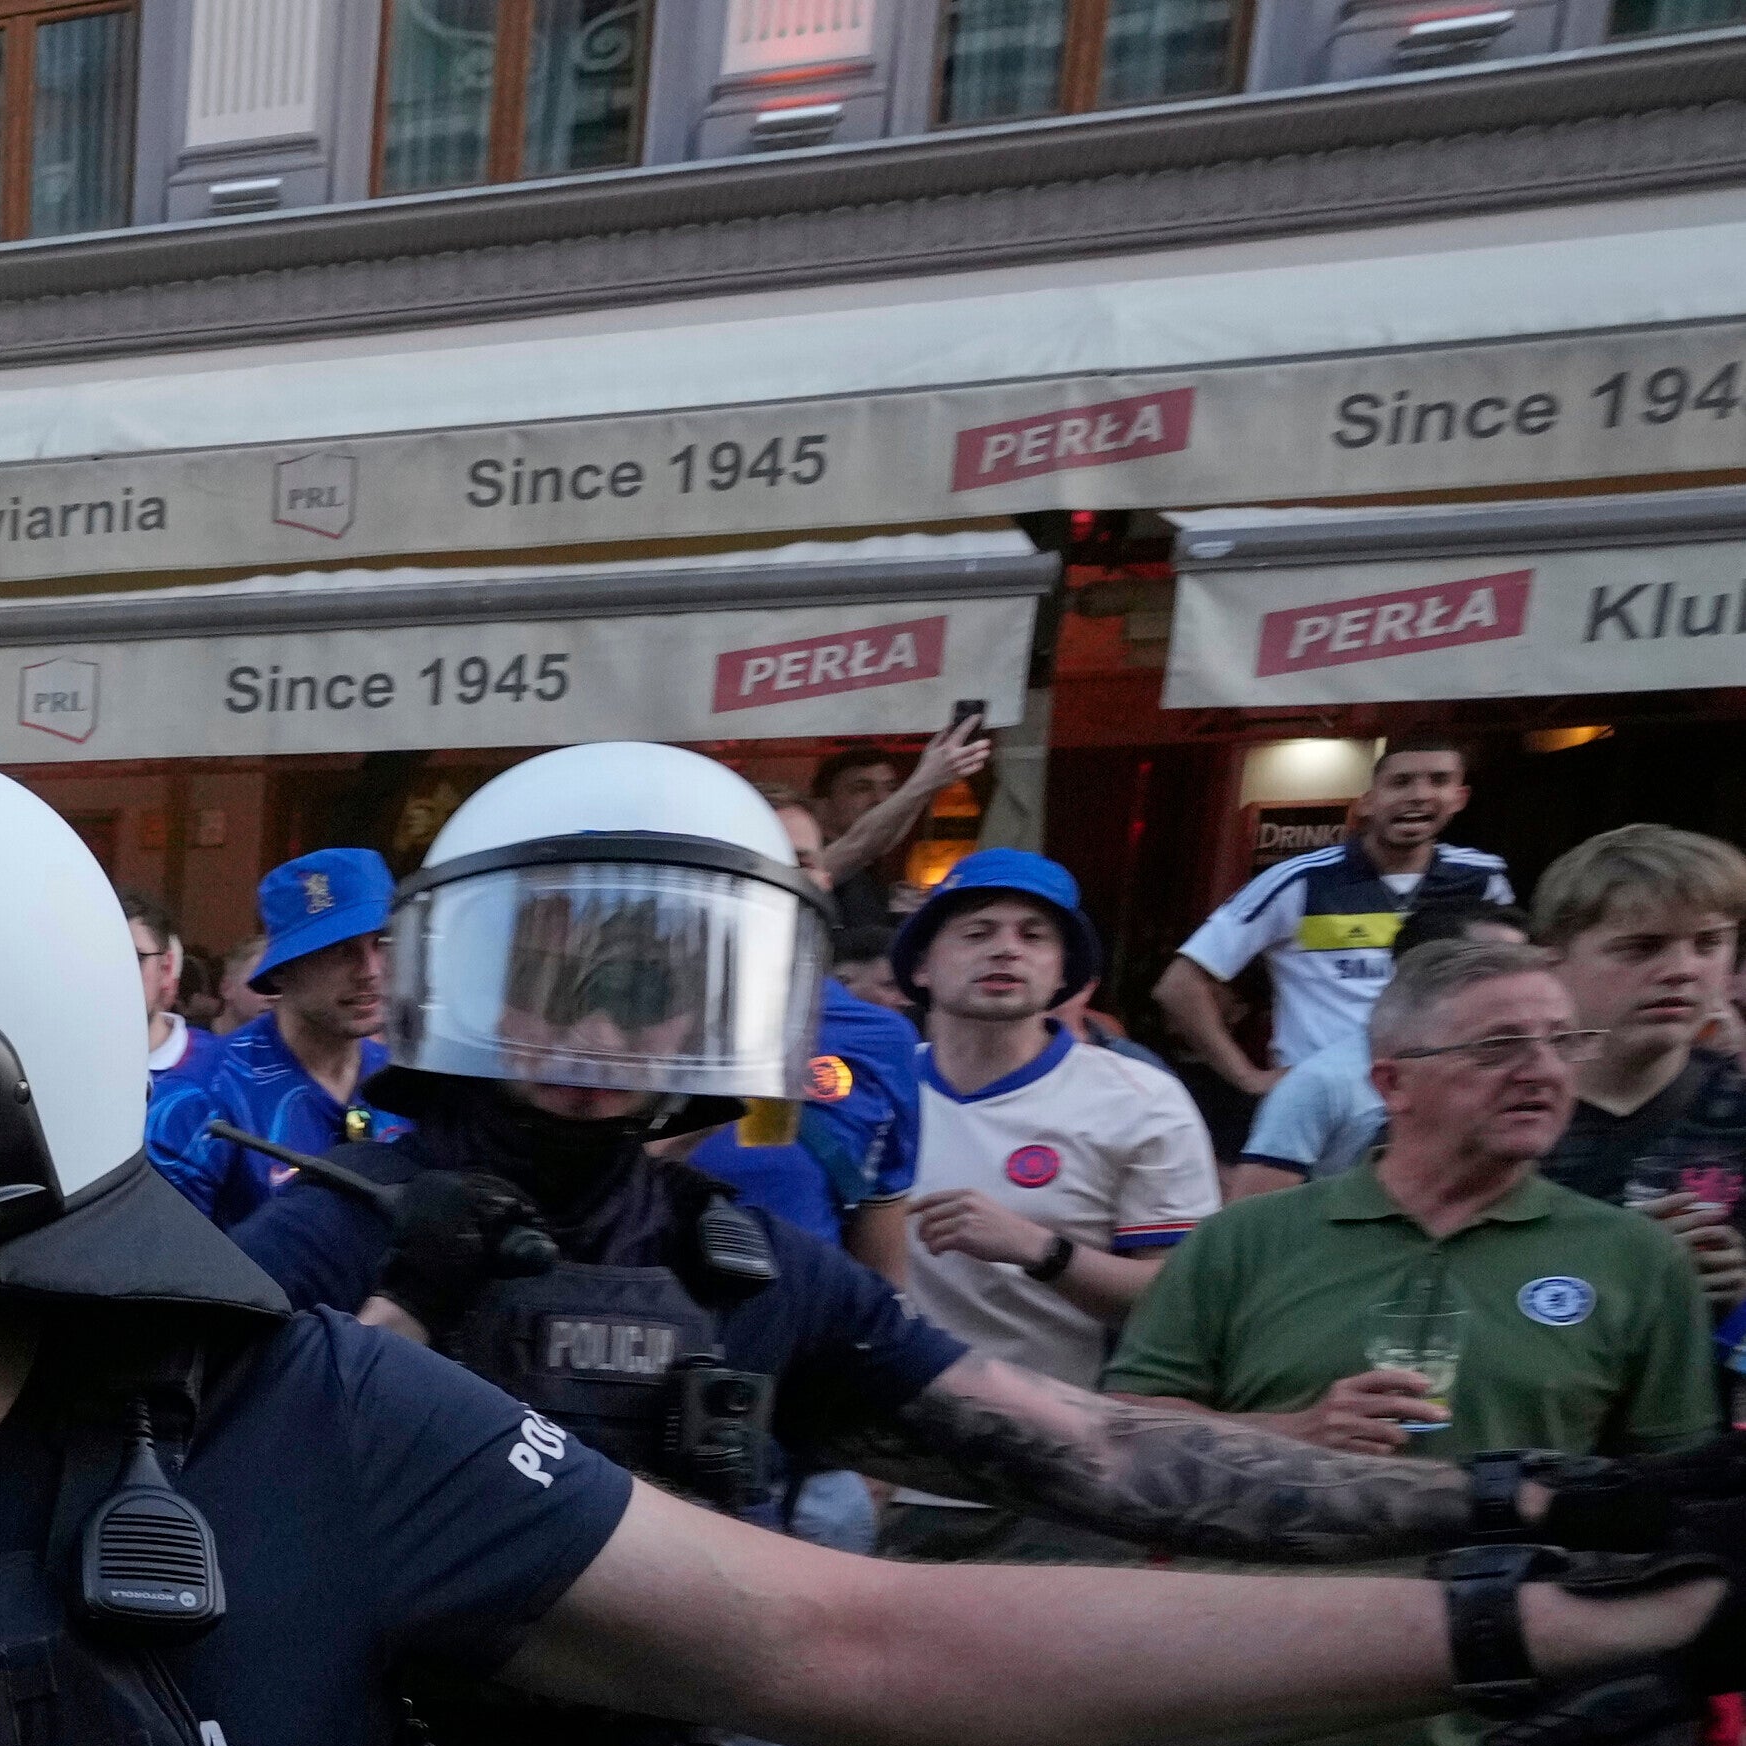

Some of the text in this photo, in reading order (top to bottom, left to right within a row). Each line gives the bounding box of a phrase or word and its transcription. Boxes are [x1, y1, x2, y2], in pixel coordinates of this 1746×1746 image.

[976, 402, 1167, 476] PERŁA
[1332, 391, 1559, 450] Since
[466, 434, 827, 510] Since 1945
[1284, 586, 1502, 660] PERŁA
[224, 652, 571, 715] Since 1945
[739, 629, 919, 697] PERŁA
